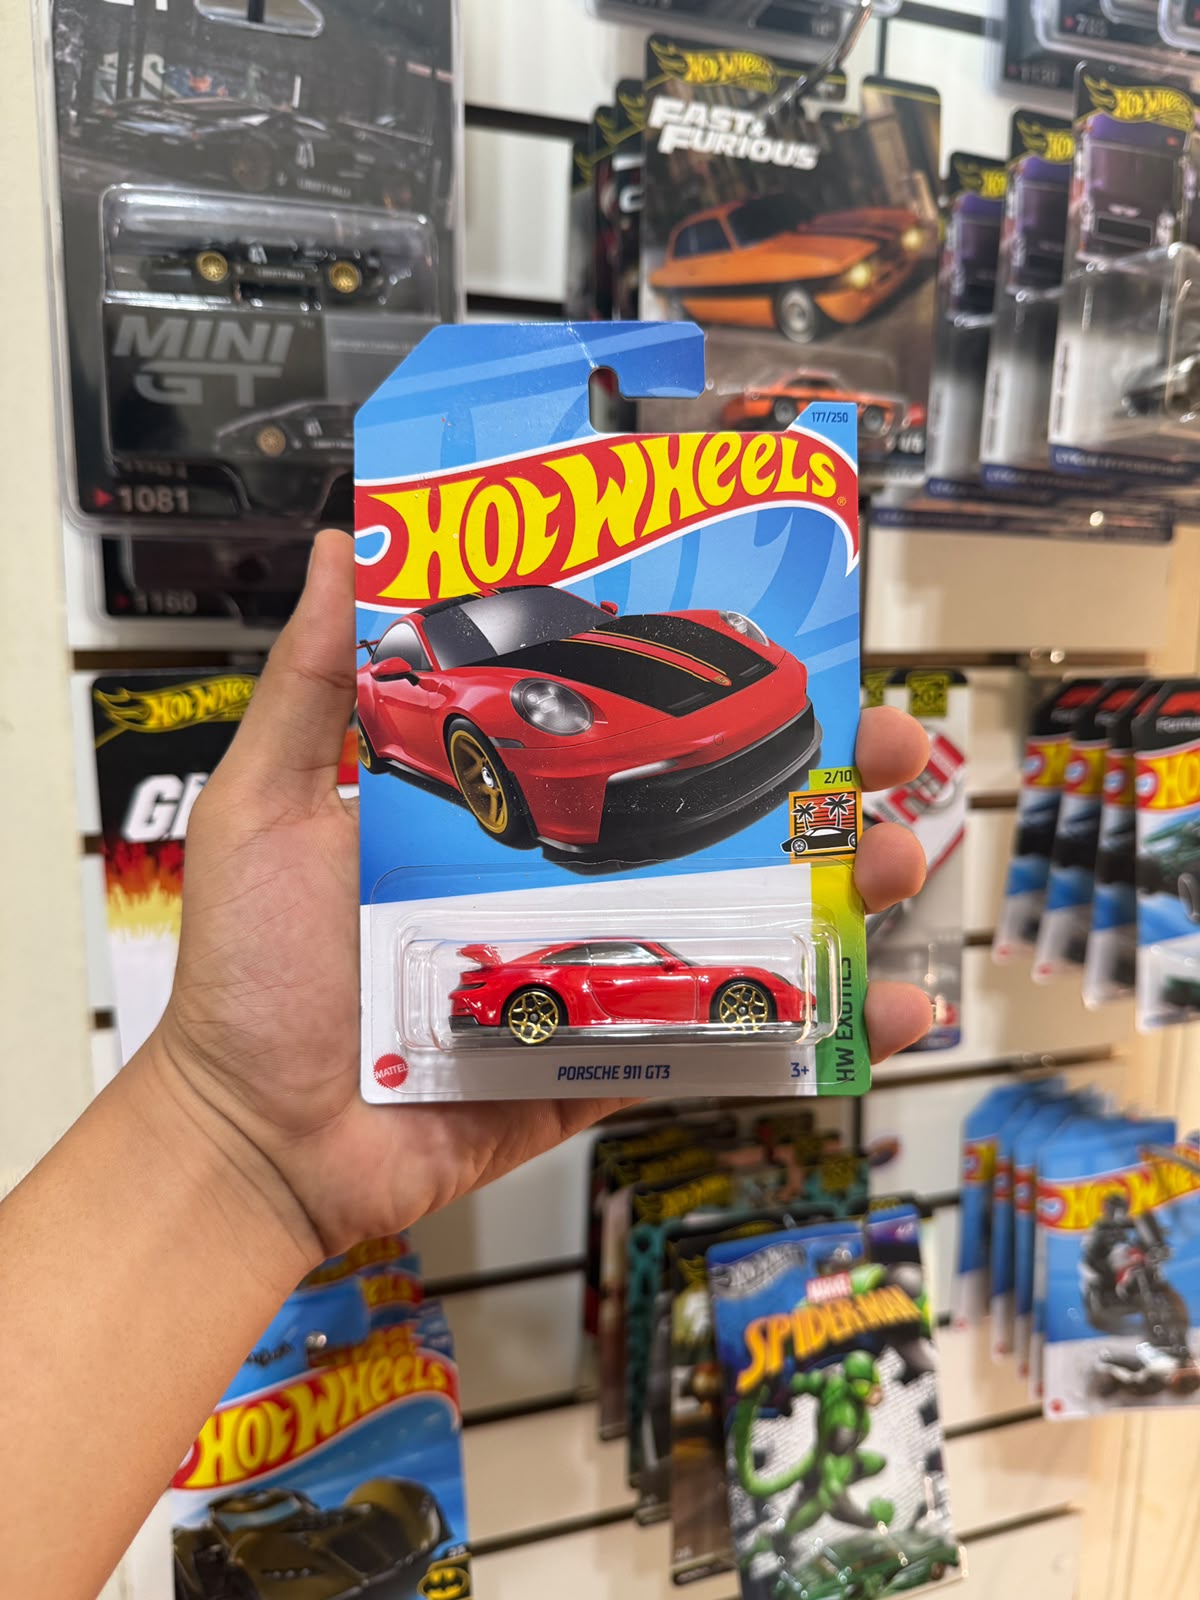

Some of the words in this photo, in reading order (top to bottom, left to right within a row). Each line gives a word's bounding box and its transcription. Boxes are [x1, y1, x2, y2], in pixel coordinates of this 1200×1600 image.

[649, 96, 751, 134] FAST
[657, 124, 823, 170] FURIOUS
[111, 315, 295, 363] MINI
[132, 360, 284, 407] GT
[811, 411, 849, 424] 177/250
[117, 485, 189, 514] 1081
[824, 770, 852, 784] 2/10
[375, 1063, 408, 1079] MATTEL
[557, 1065, 621, 1081] PORSCHE
[623, 1065, 641, 1080] 911
[645, 1064, 671, 1080] GT3
[790, 1062, 810, 1078] 3+
[835, 1047, 856, 1082] HW
